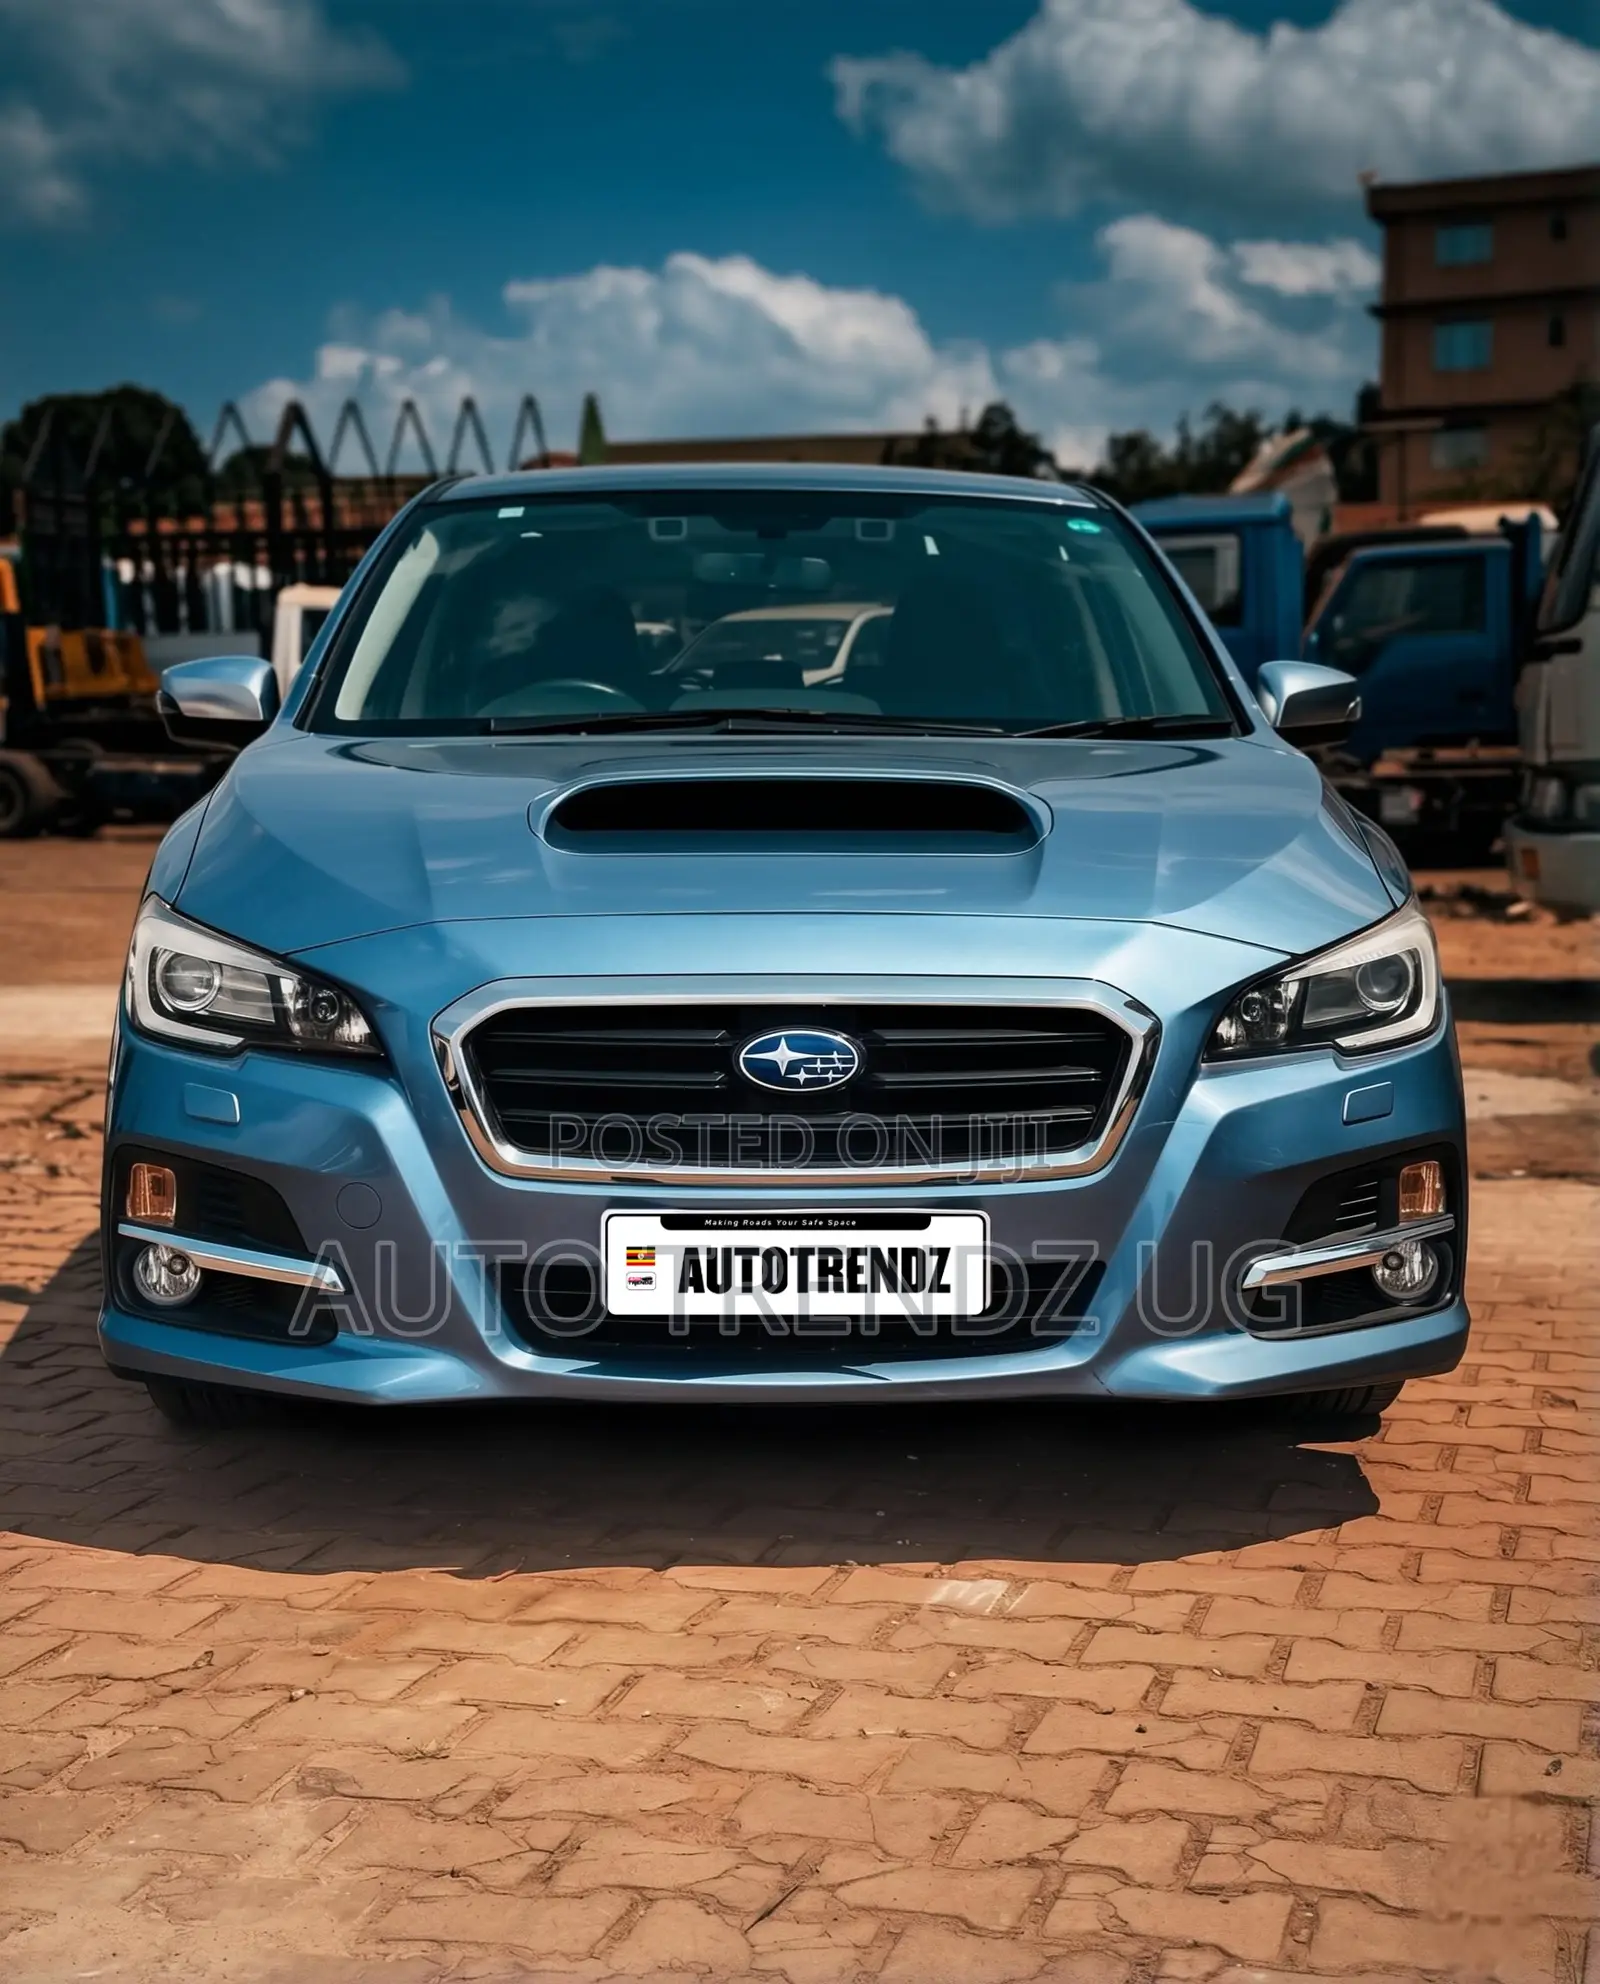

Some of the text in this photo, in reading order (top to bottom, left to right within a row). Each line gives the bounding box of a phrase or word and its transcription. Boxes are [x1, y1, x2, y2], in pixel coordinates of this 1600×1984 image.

[704, 1219, 739, 1227] Making
[827, 1219, 857, 1227] Space
[678, 1246, 952, 1295] AUTOTRENDZ
